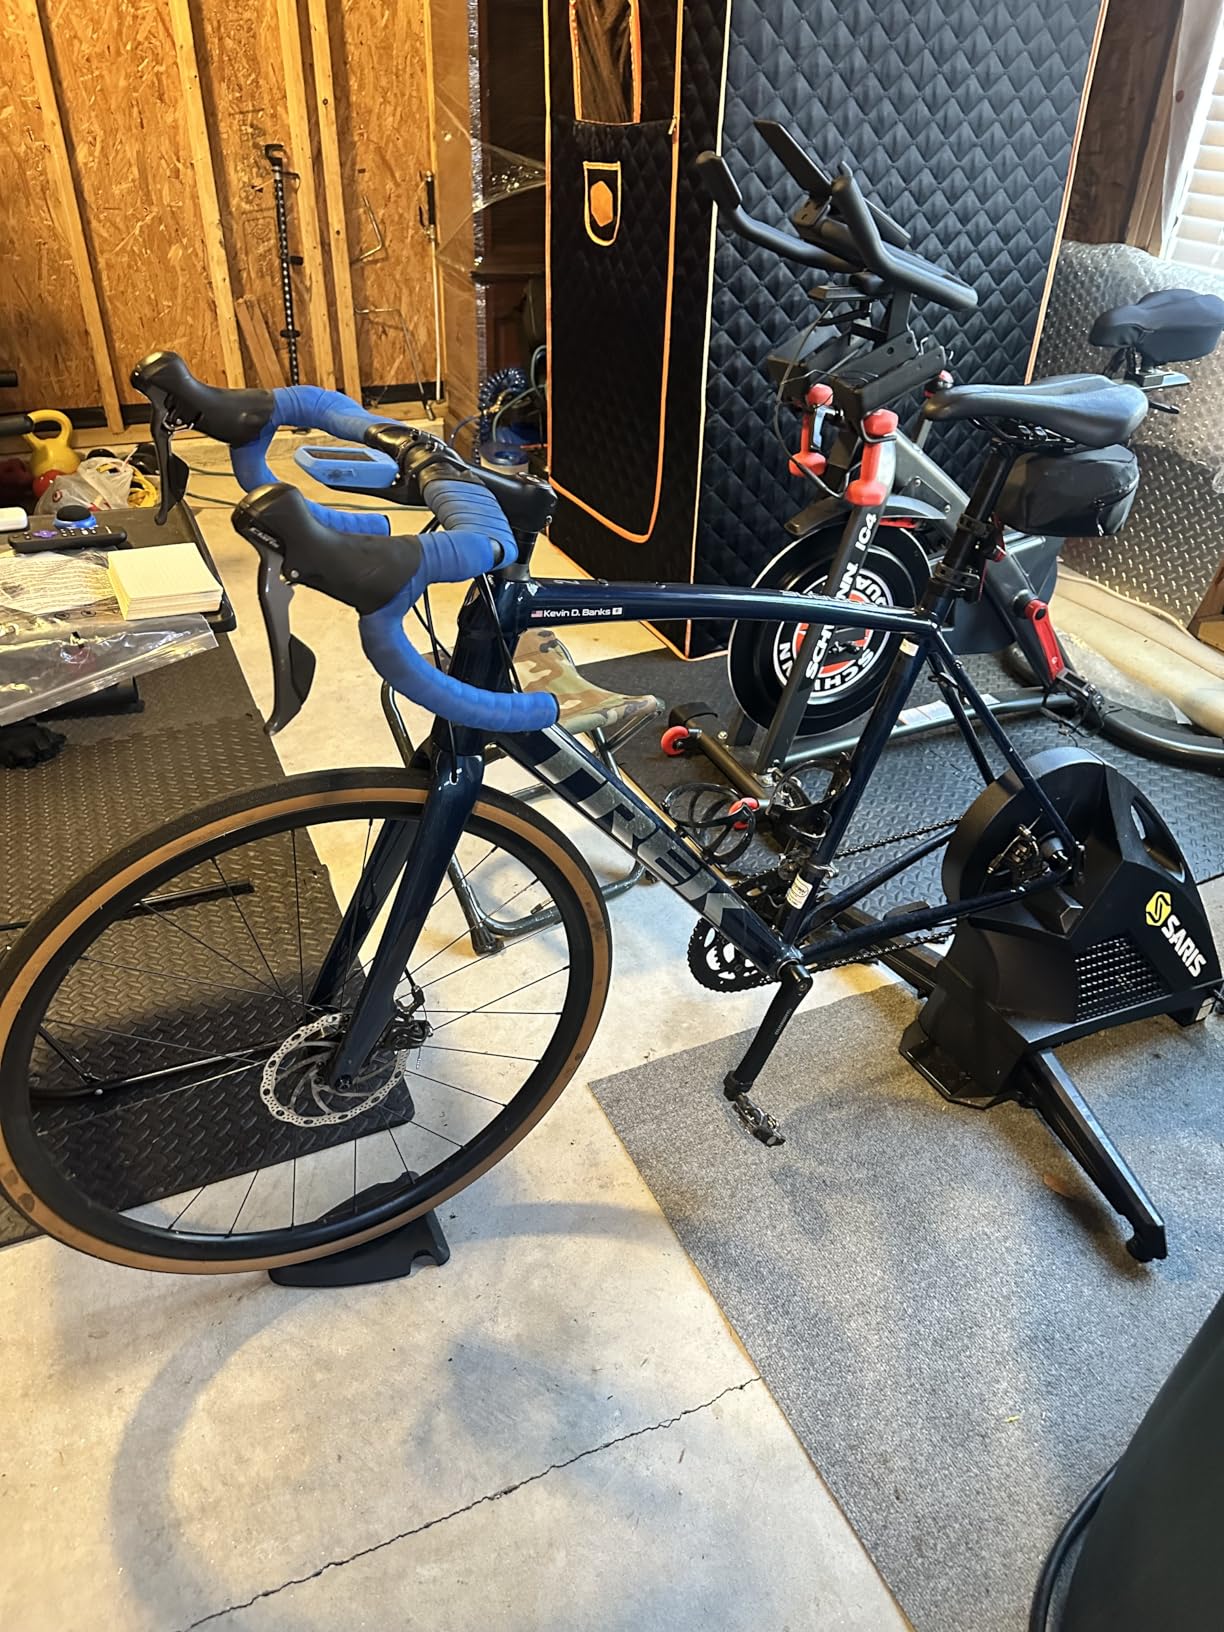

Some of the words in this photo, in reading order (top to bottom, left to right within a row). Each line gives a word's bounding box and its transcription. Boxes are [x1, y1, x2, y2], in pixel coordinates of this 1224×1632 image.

[543, 609, 569, 618] Kevin
[571, 609, 581, 617] D.
[582, 608, 611, 616] Banks
[806, 562, 858, 679] SCHNN
[855, 513, 877, 551] IC4
[535, 725, 745, 927] TREK
[1161, 914, 1207, 977] SARIS
